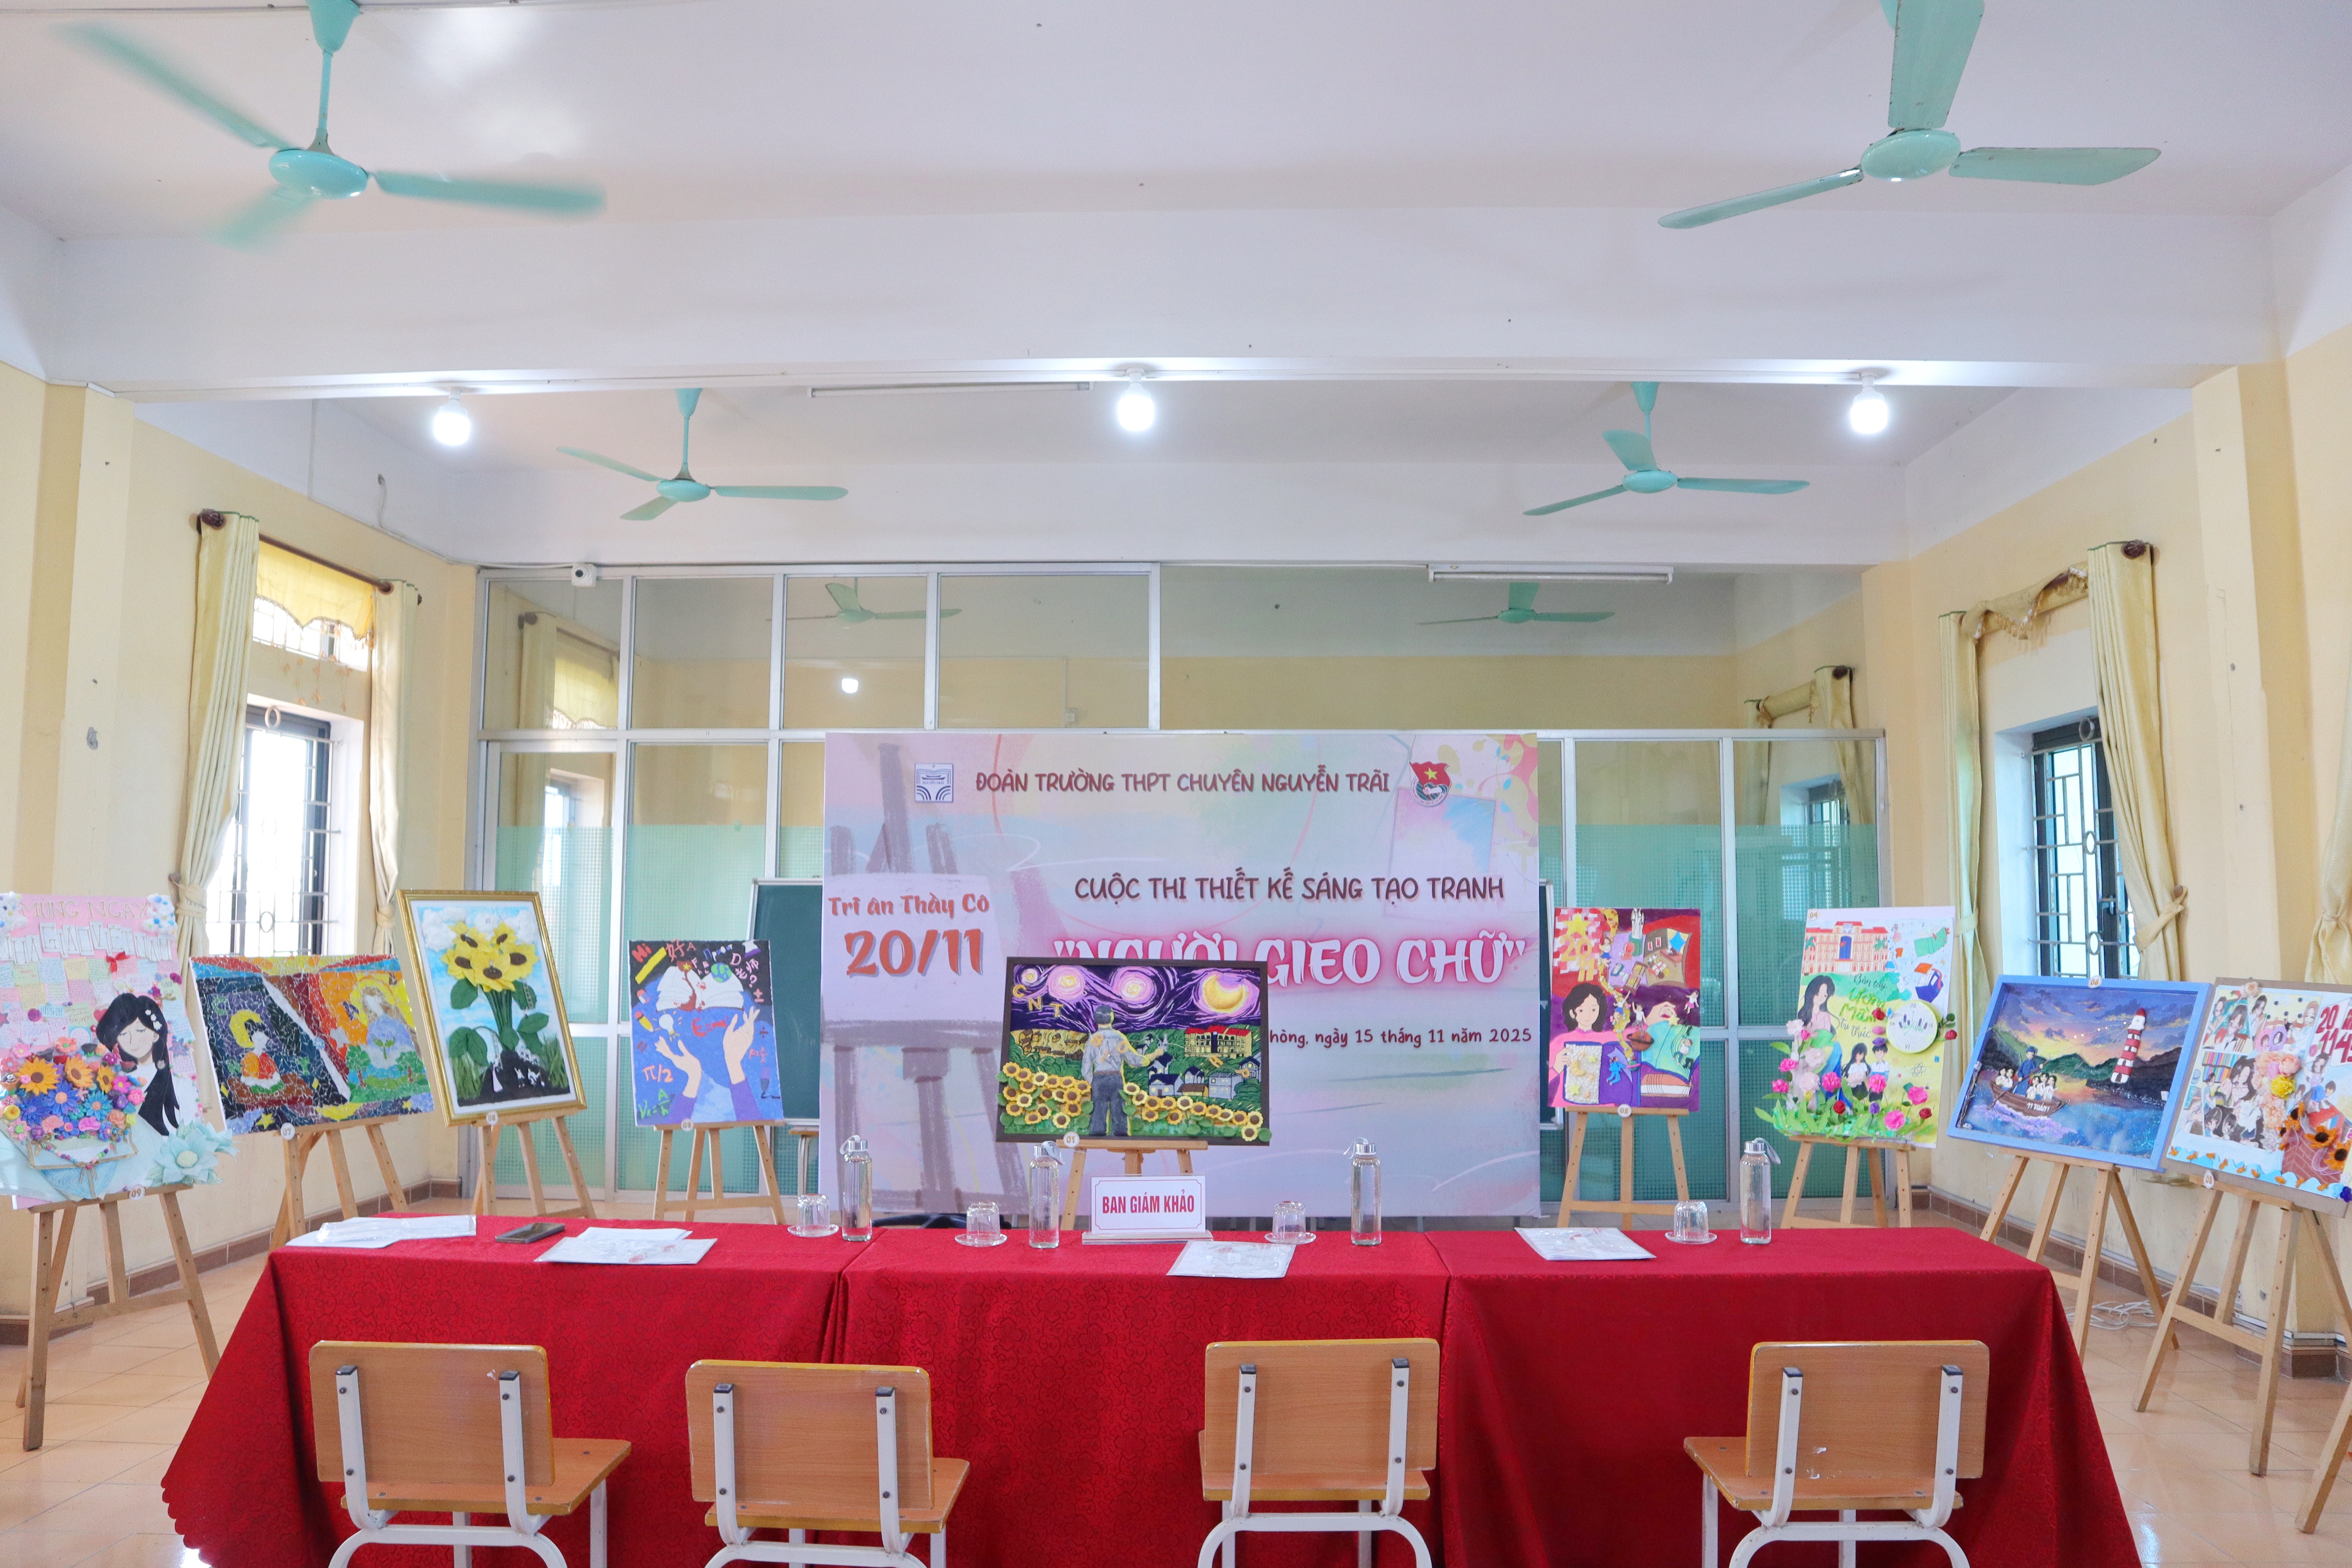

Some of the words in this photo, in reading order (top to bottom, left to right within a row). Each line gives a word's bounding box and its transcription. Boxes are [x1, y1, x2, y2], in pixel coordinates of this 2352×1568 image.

[975, 769, 1028, 792] ĐOÀN
[1035, 768, 1114, 792] TRƯỜNG
[1121, 773, 1171, 792] THPT
[1177, 768, 1254, 792] CHUYÊN
[1262, 764, 1339, 792] NGUYỄN
[1346, 769, 1390, 792] TRÃI
[1075, 872, 1140, 904] CUỘC
[1148, 877, 1186, 899] THI
[1195, 867, 1259, 899] THIẾT
[1268, 867, 1293, 899] KẾ
[1302, 872, 1362, 900] SÁNG
[1371, 877, 1418, 905] TẠO
[1427, 877, 1504, 900] TRANH
[867, 897, 894, 915] ân
[962, 893, 990, 912] Cô
[134, 936, 172, 962] NAM
[687, 942, 696, 951] A
[730, 953, 741, 965] D
[844, 929, 983, 976] 20/11
[1560, 934, 1592, 962] 20
[1255, 938, 1380, 987] GIEO
[1577, 956, 1595, 982] 11
[1873, 980, 1887, 991] tay
[2316, 1004, 2339, 1033] 20
[1270, 1029, 1308, 1048] hòng.
[1316, 1028, 1348, 1047] ngày
[1355, 1029, 1373, 1043] 15
[1381, 1027, 1421, 1048] tháng
[1428, 1029, 1444, 1042] 11
[1452, 1027, 1482, 1043] năm
[1489, 1028, 1531, 1042] 2025
[2319, 1027, 2339, 1056] 11
[283, 1127, 291, 1136] 07
[131, 1188, 142, 1198] 09
[1102, 1196, 1126, 1214] BAN
[1130, 1192, 1160, 1213] GIÁM
[1164, 1189, 1194, 1212] KHẢO
